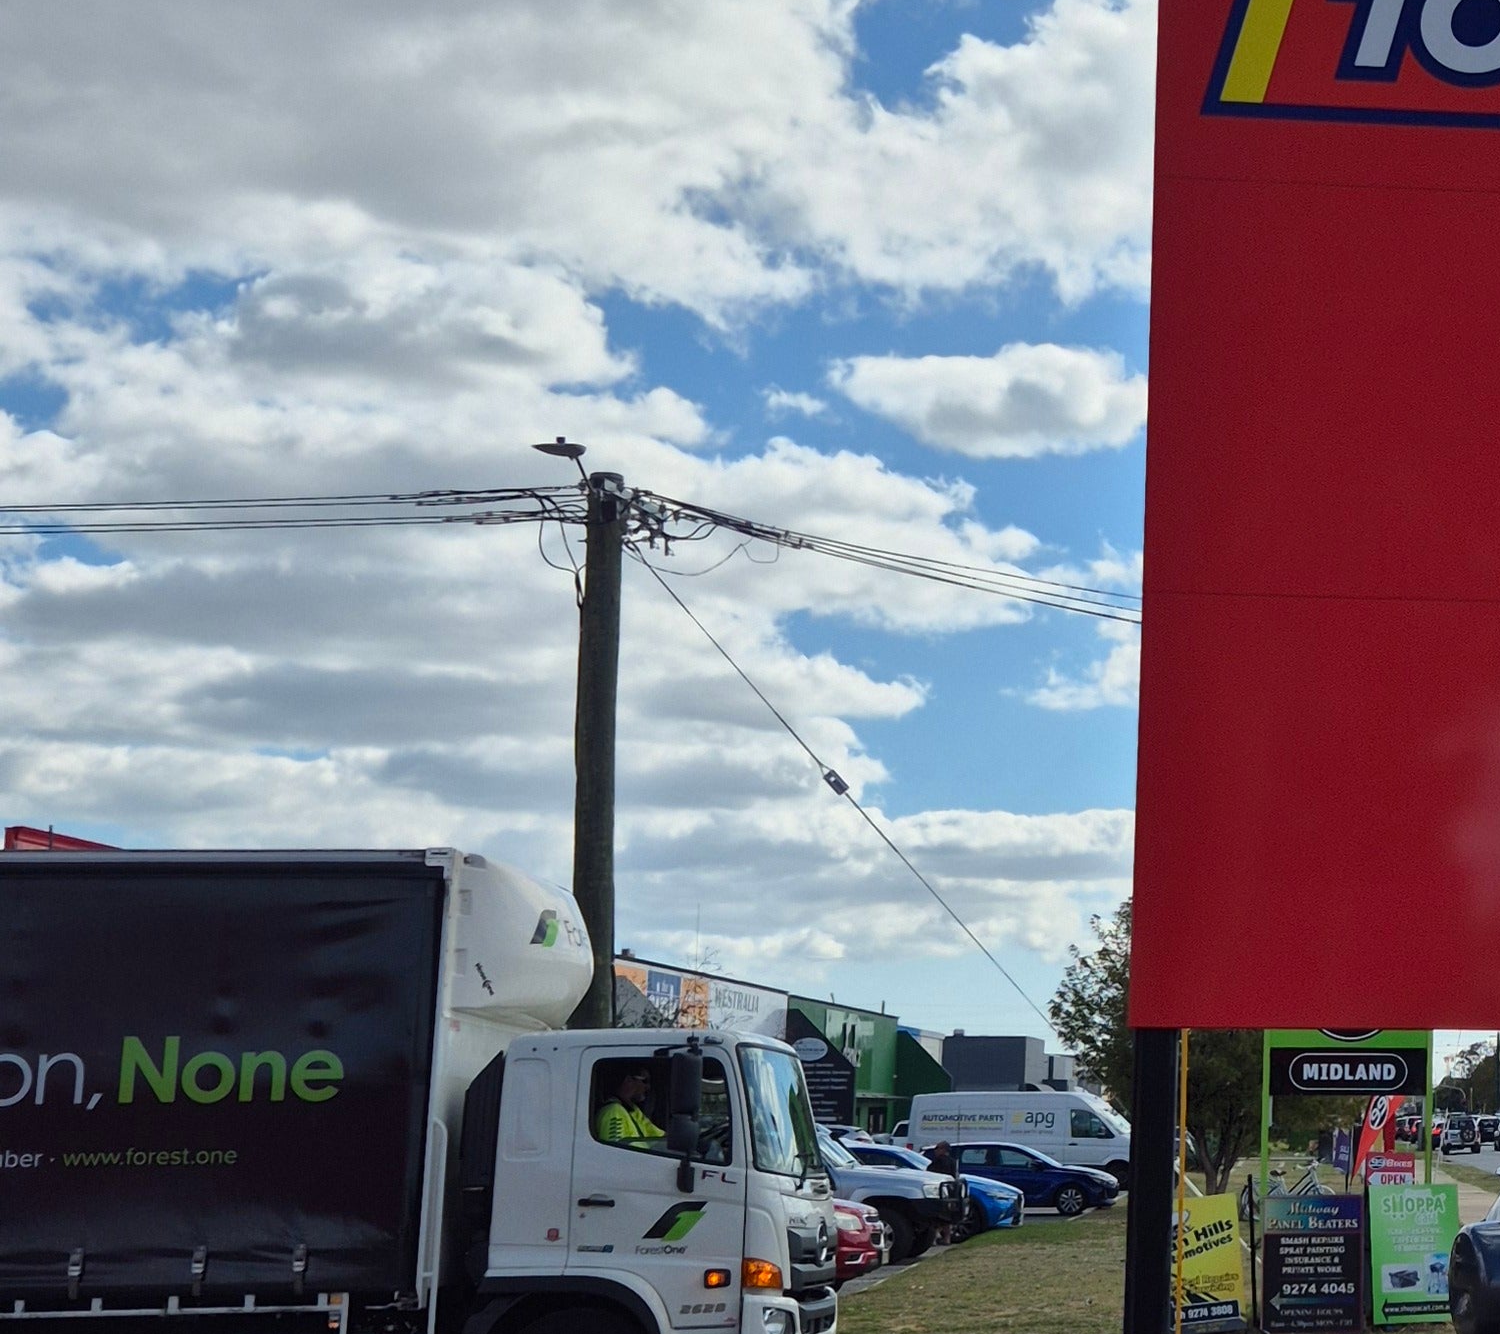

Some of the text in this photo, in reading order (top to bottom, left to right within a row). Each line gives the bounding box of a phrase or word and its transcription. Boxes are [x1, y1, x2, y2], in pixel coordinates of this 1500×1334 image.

[715, 988, 759, 1013] WESTRALIA
[118, 1035, 344, 1104] None
[1302, 1063, 1397, 1081] MIDLAND
[922, 1114, 1004, 1122] AUTOMOTIVE PARTS
[1024, 1111, 1055, 1129] apg
[63, 1148, 238, 1166] www.forest.one
[702, 1170, 738, 1184] FL
[1381, 1173, 1407, 1184] OPEN
[1289, 1202, 1339, 1215] Midway
[1308, 1217, 1358, 1229] BEATERS
[1194, 1219, 1233, 1241] Hills
[1281, 1236, 1345, 1245] SMASH REPAIRS
[1307, 1246, 1345, 1254] PAINTING
[1284, 1256, 1331, 1264] INSURANCE
[1282, 1266, 1315, 1274] PRIVATE
[1282, 1283, 1355, 1295] 9274 4045
[1188, 1307, 1208, 1319] 9274
